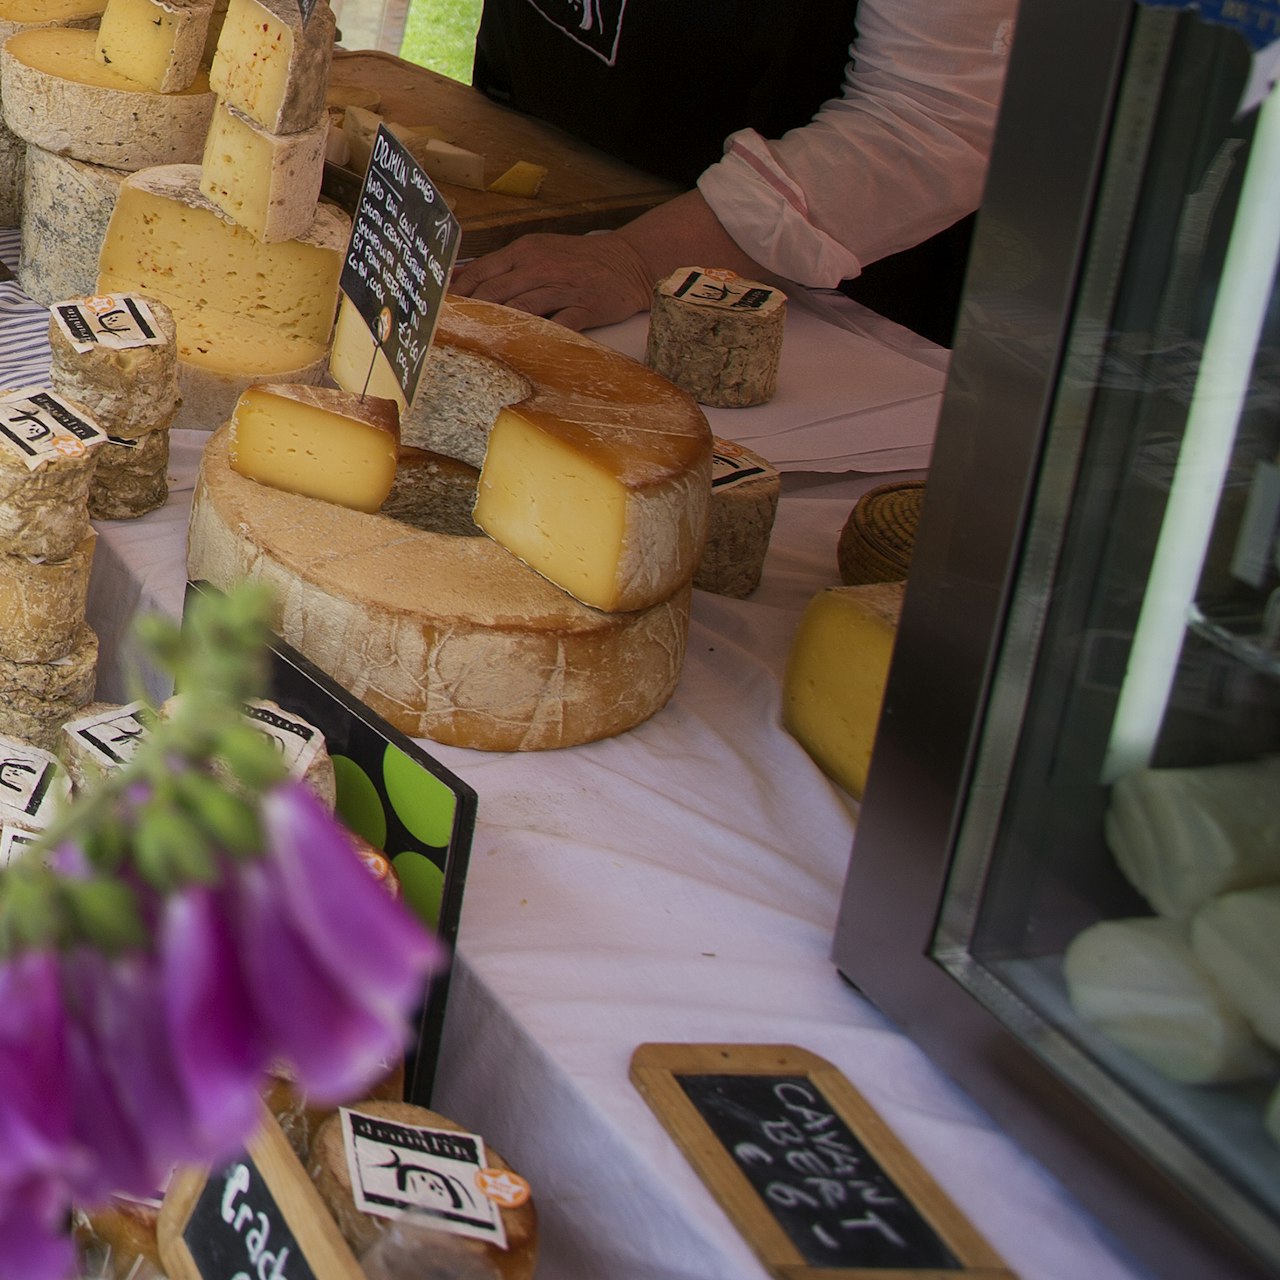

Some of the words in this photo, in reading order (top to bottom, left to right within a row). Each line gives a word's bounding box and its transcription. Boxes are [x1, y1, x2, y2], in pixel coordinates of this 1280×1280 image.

[374, 135, 410, 188] DRUMLIN
[366, 171, 384, 200] HARD
[359, 1122, 472, 1160] drumlin
